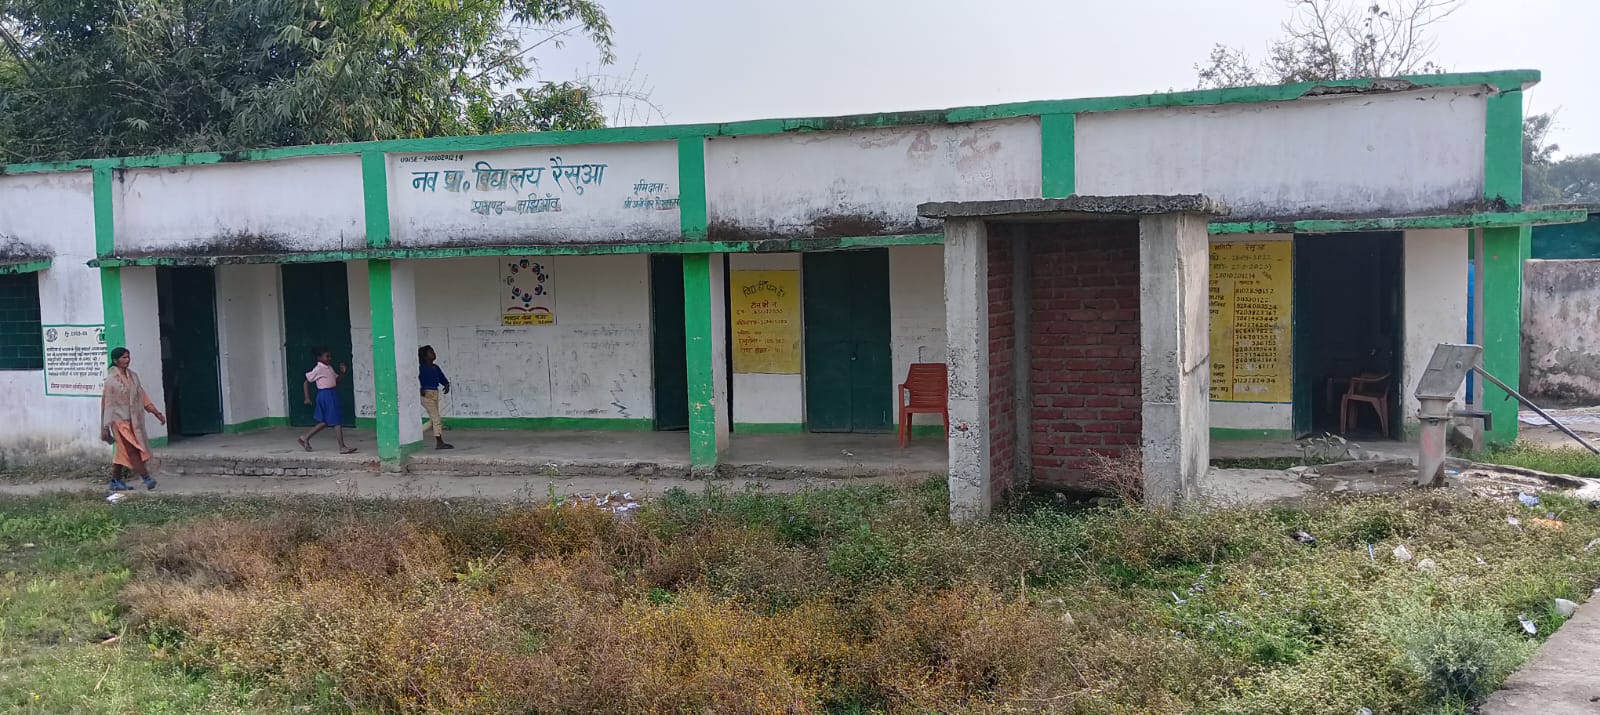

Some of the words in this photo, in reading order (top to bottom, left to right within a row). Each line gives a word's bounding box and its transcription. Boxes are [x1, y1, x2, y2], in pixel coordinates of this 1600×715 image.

[411, 171, 440, 193] नव
[472, 160, 546, 194] विद्यालय
[550, 156, 608, 196] रैसुआ
